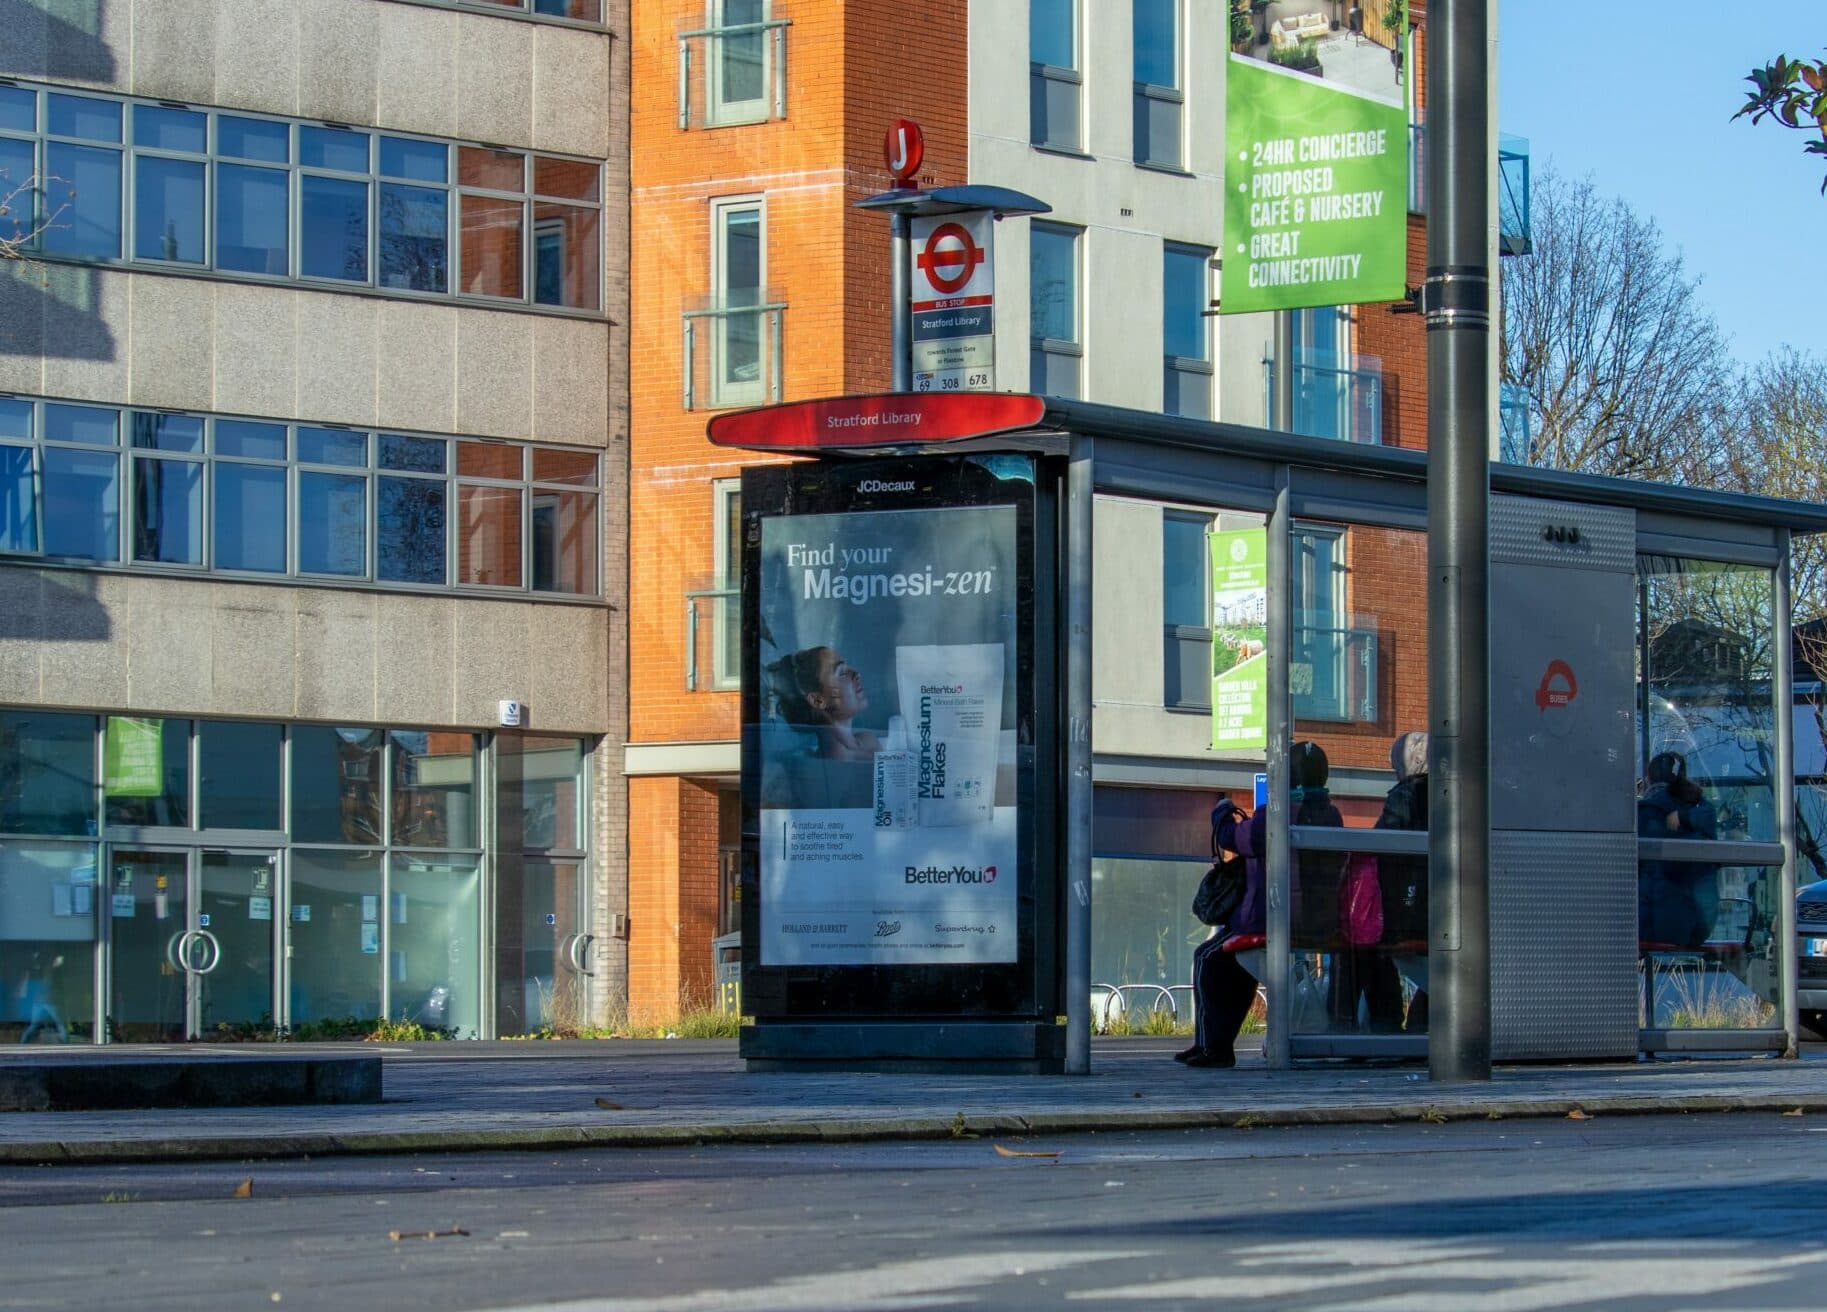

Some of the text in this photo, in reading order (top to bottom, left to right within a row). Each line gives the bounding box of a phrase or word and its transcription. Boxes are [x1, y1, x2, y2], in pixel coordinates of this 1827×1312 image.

[892, 127, 907, 170] J
[1252, 129, 1386, 167] 24HR CONCIERGE
[1251, 166, 1333, 199] PROPOSED
[1294, 198, 1304, 223] &
[1310, 191, 1384, 222] NURSERY
[1250, 231, 1300, 259] GREAT
[1248, 254, 1361, 288] CONNECTIVITY
[935, 298, 965, 308] BUS STOP
[922, 316, 980, 329] Stratford Library
[919, 380, 930, 392] 69
[942, 378, 959, 389] 308
[969, 374, 987, 386] 678
[827, 412, 922, 428] Stratford Library
[857, 480, 915, 493] JCDecaux
[787, 542, 892, 572] Find your
[917, 696, 934, 799] Magnesium
[932, 742, 946, 799] Flakes
[875, 761, 886, 827] Magnesium
[883, 811, 892, 827] Oil
[792, 832, 805, 840] and
[807, 831, 837, 840] effective
[791, 853, 805, 861] and
[904, 866, 982, 884] BetterYou
[934, 924, 985, 935] Superdrug
